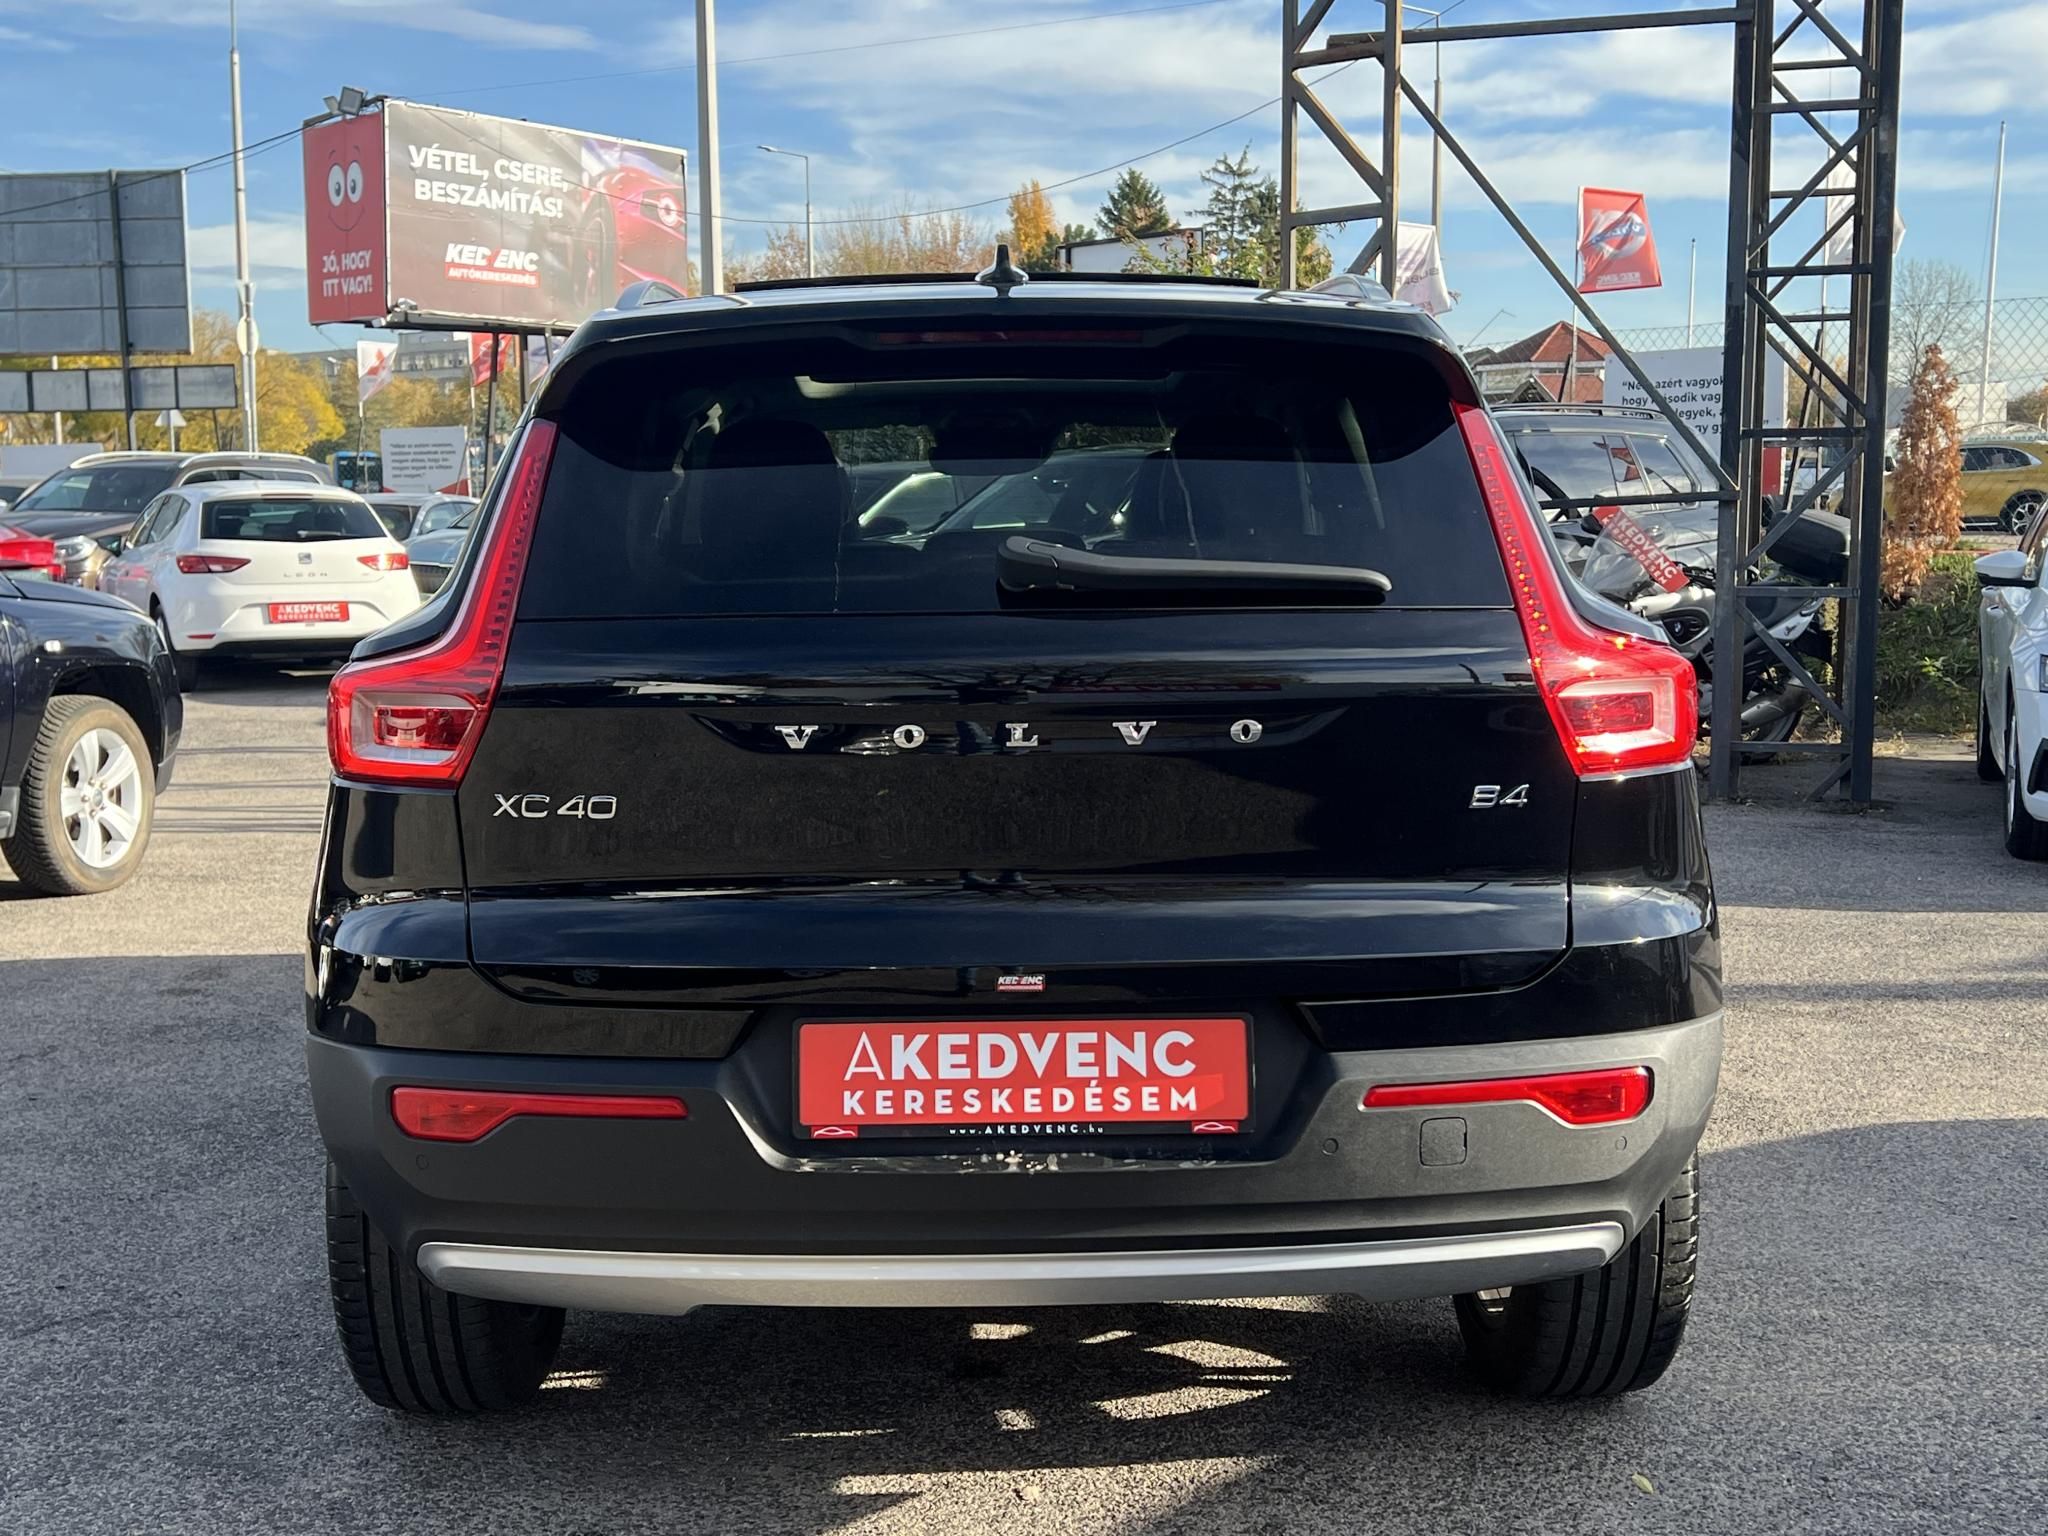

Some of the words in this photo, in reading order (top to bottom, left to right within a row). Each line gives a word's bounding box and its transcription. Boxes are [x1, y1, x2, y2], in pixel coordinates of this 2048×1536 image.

[408, 143, 490, 181] VÉTEL,
[493, 158, 570, 193] CSERE,
[414, 178, 564, 219] BESZÁMÍTÁS!
[322, 249, 340, 276] JÓ,
[341, 249, 372, 272] HOGY
[322, 278, 339, 297] ITT
[340, 274, 373, 296] VAGY!
[1622, 380, 1644, 391] “Ne
[1655, 378, 1683, 390] azért
[1622, 396, 1649, 408] hogy
[774, 719, 1263, 749] VOLVO
[1468, 783, 1530, 809] B4
[843, 1030, 1197, 1081] AKEDVENC
[842, 1080, 1198, 1116] KERESKEDÉSEM
[949, 1123, 1104, 1135] www.AKEDVENC.hu
